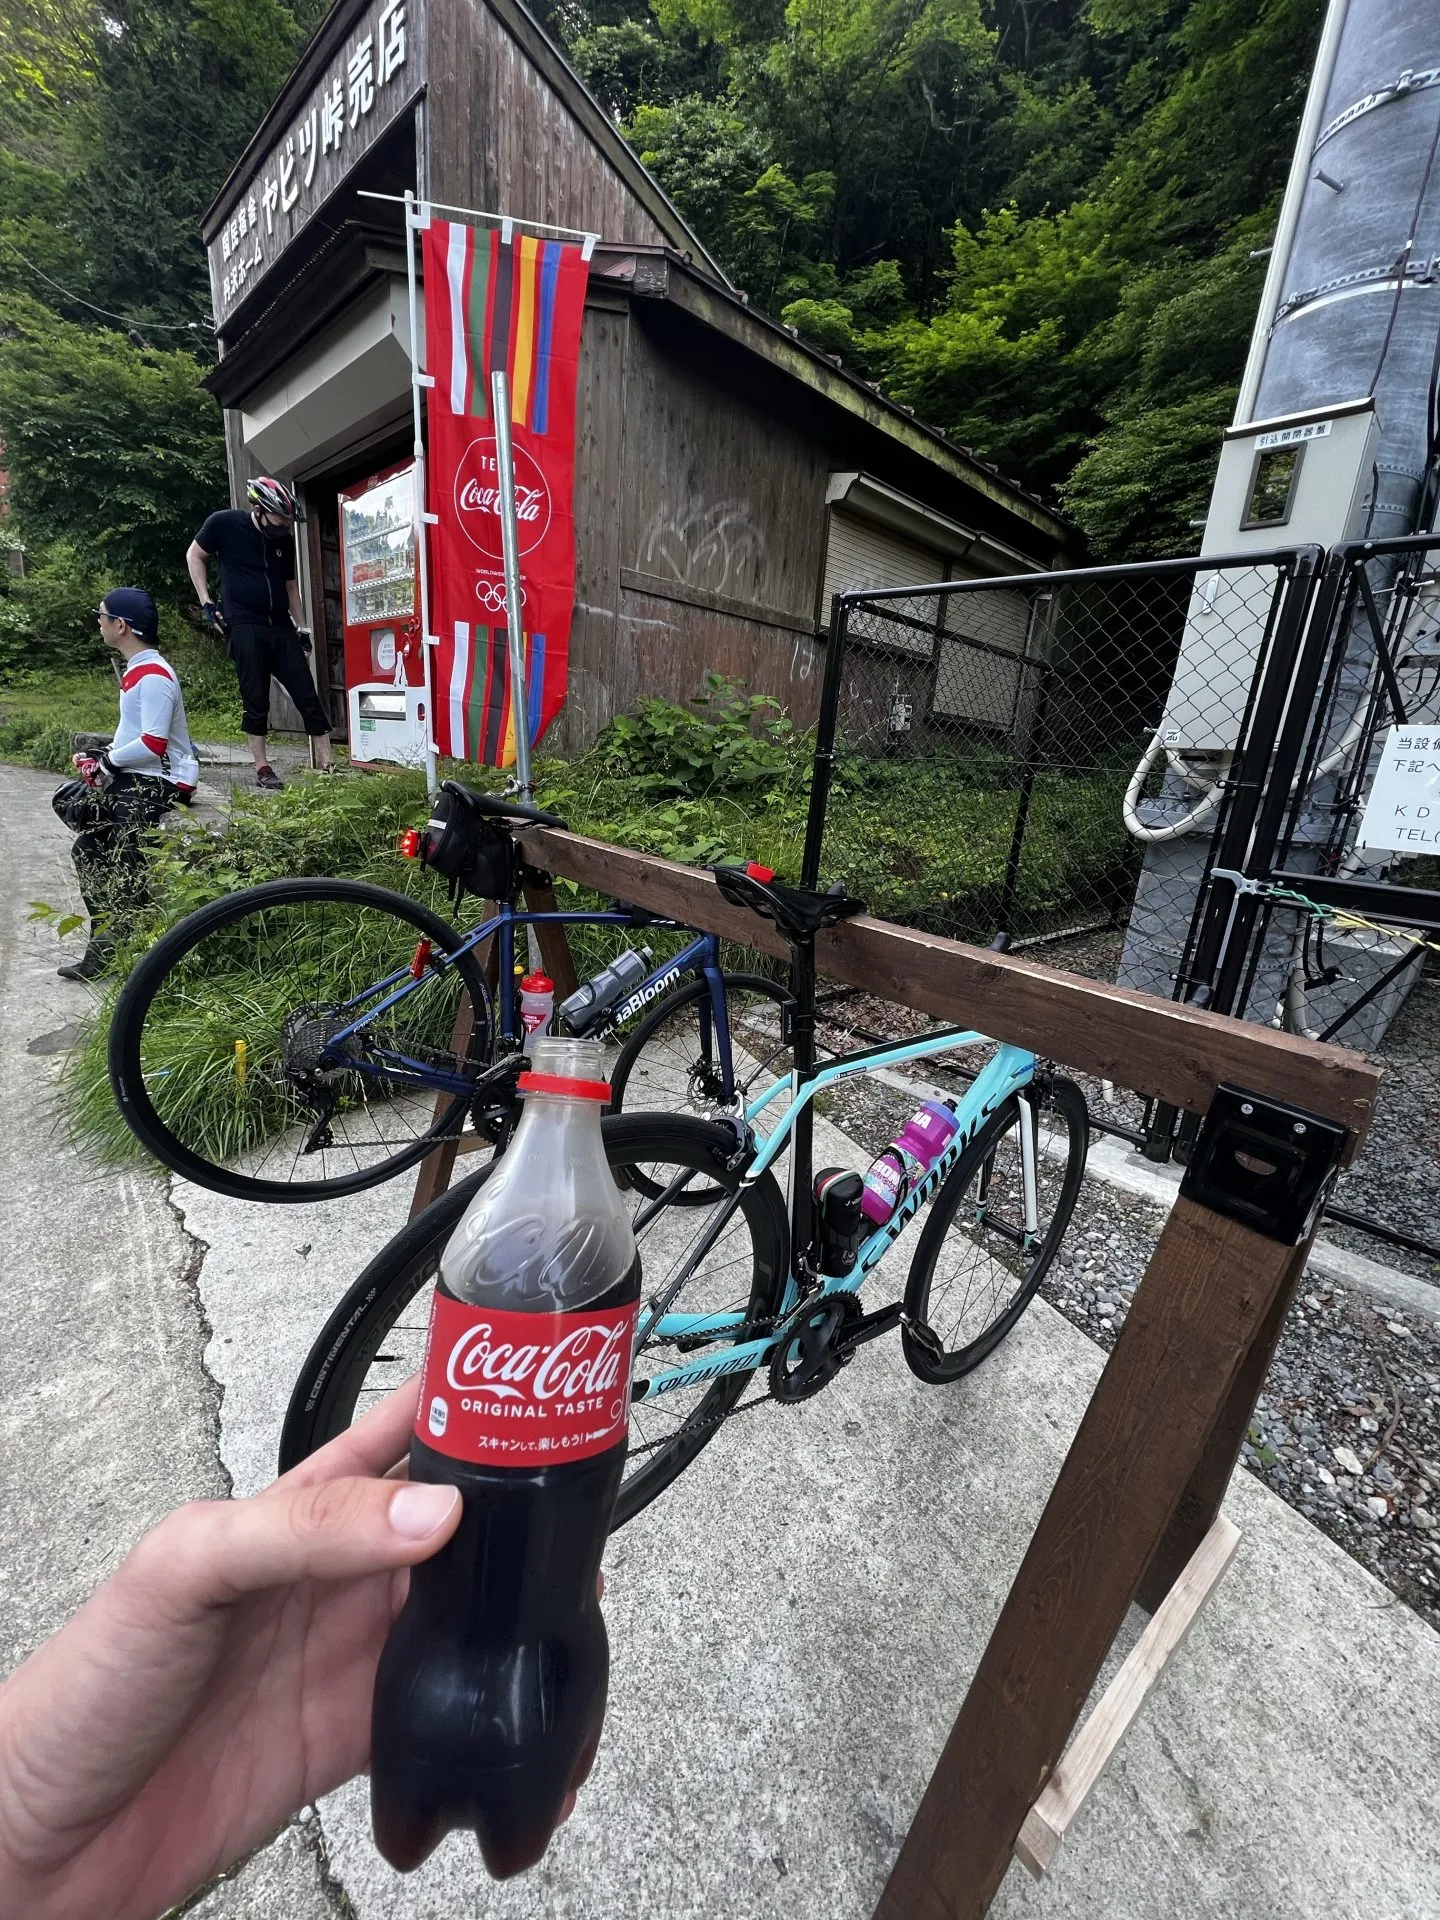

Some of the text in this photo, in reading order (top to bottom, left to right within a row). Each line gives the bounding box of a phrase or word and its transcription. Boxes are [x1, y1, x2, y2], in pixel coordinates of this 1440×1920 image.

[262, 0, 406, 235] ヤビツ峠売店
[481, 455, 516, 475] TE
[310, 1302, 368, 1399] CONTINENTAL
[446, 1320, 629, 1400] Coca-Cola
[657, 1352, 759, 1395] SPECIALIZED
[460, 1398, 547, 1417] ORIGINAL
[555, 1396, 604, 1416] TASTE
